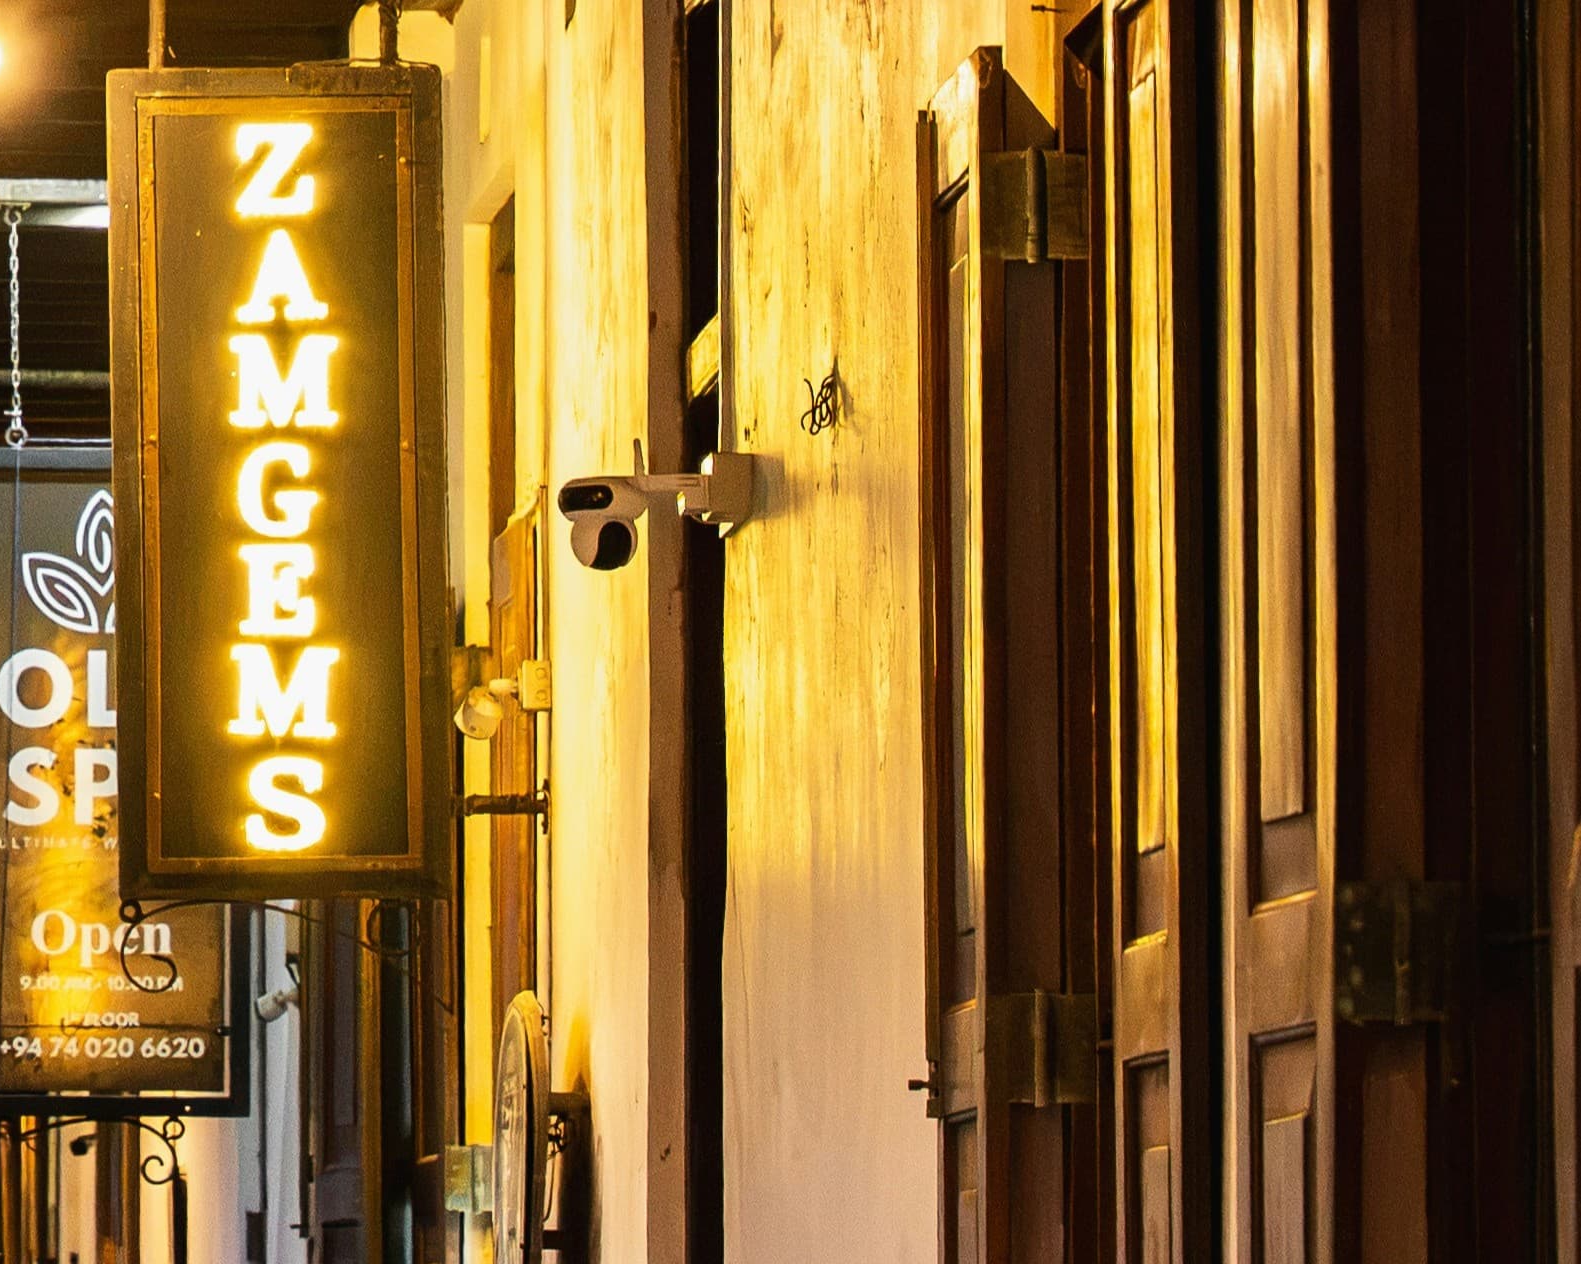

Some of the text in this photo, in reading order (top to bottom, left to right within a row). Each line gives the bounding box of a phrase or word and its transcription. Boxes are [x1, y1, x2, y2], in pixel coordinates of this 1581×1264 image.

[3, 746, 119, 826] SP
[31, 909, 172, 968] Open
[0, 1036, 205, 1059] +94 74 020 6620
